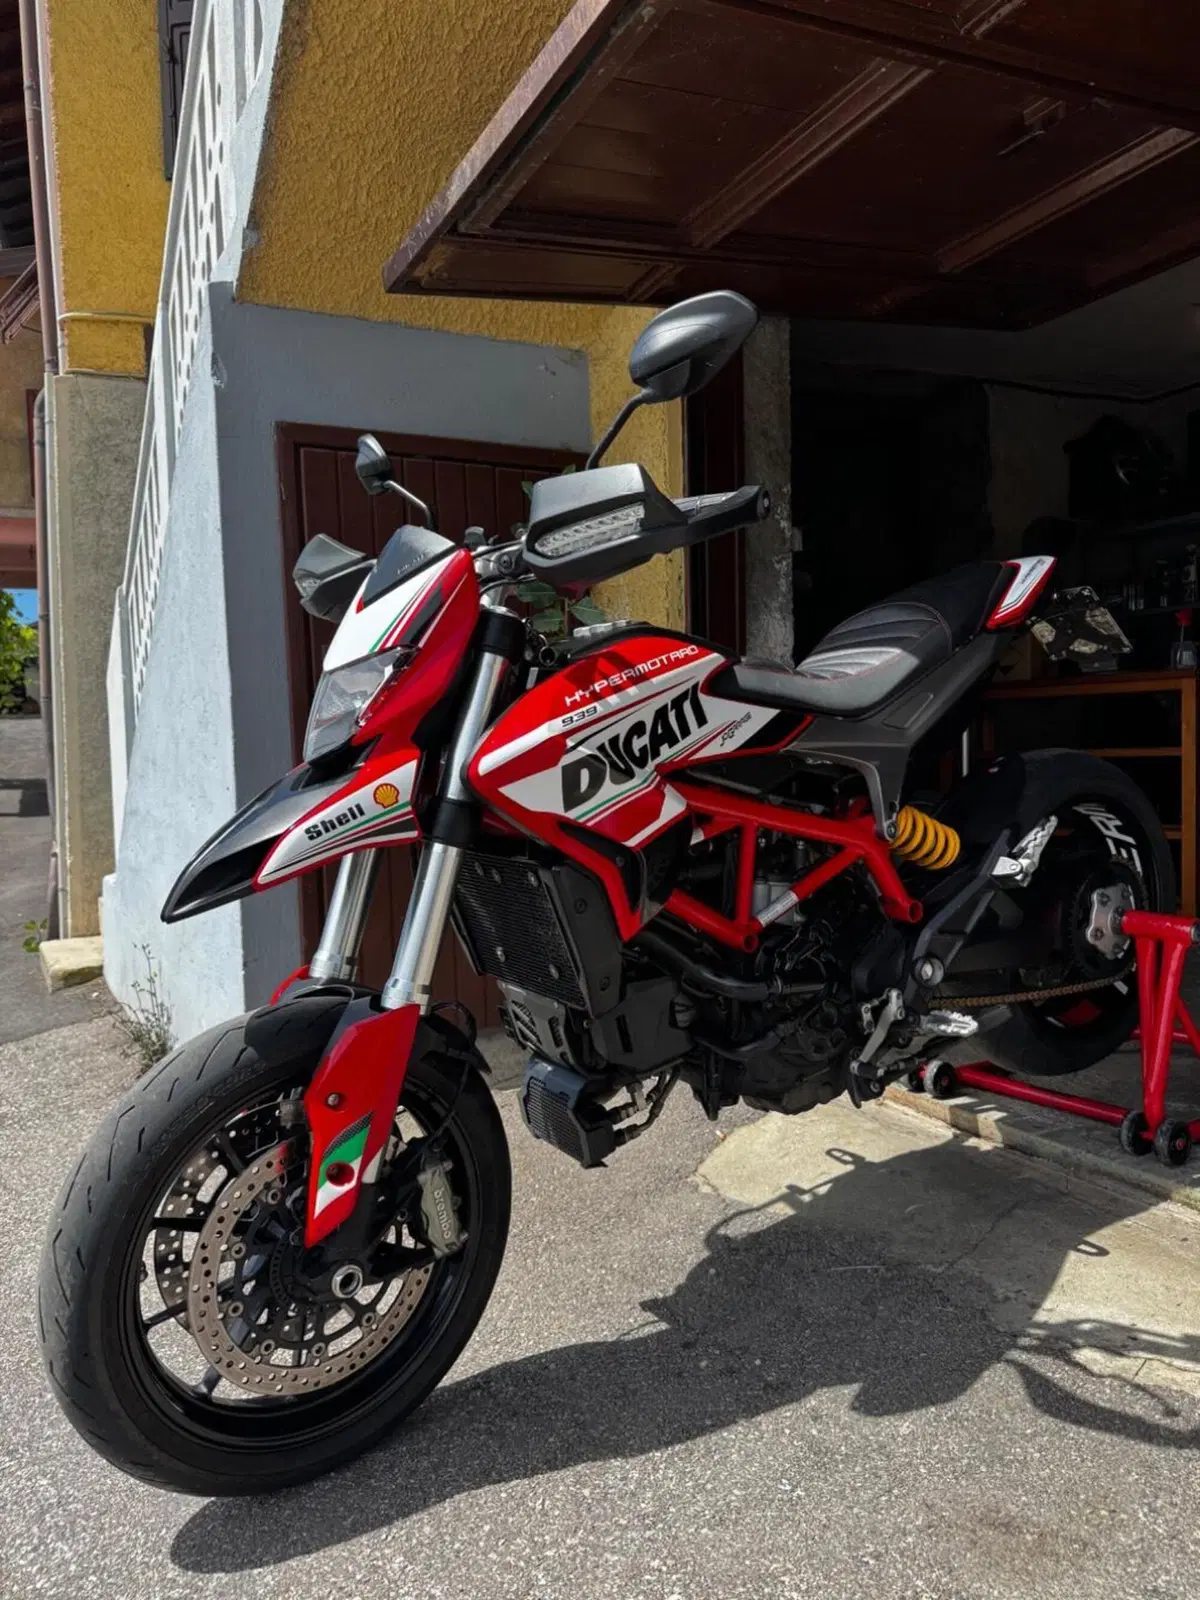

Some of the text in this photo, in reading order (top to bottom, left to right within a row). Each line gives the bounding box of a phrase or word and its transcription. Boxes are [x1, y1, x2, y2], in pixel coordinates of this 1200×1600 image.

[564, 644, 699, 707] HYPERMOTARD
[561, 705, 599, 728] 939
[561, 681, 709, 813] DUCATI
[304, 803, 366, 841] Shell
[433, 1187, 452, 1240] brembo
